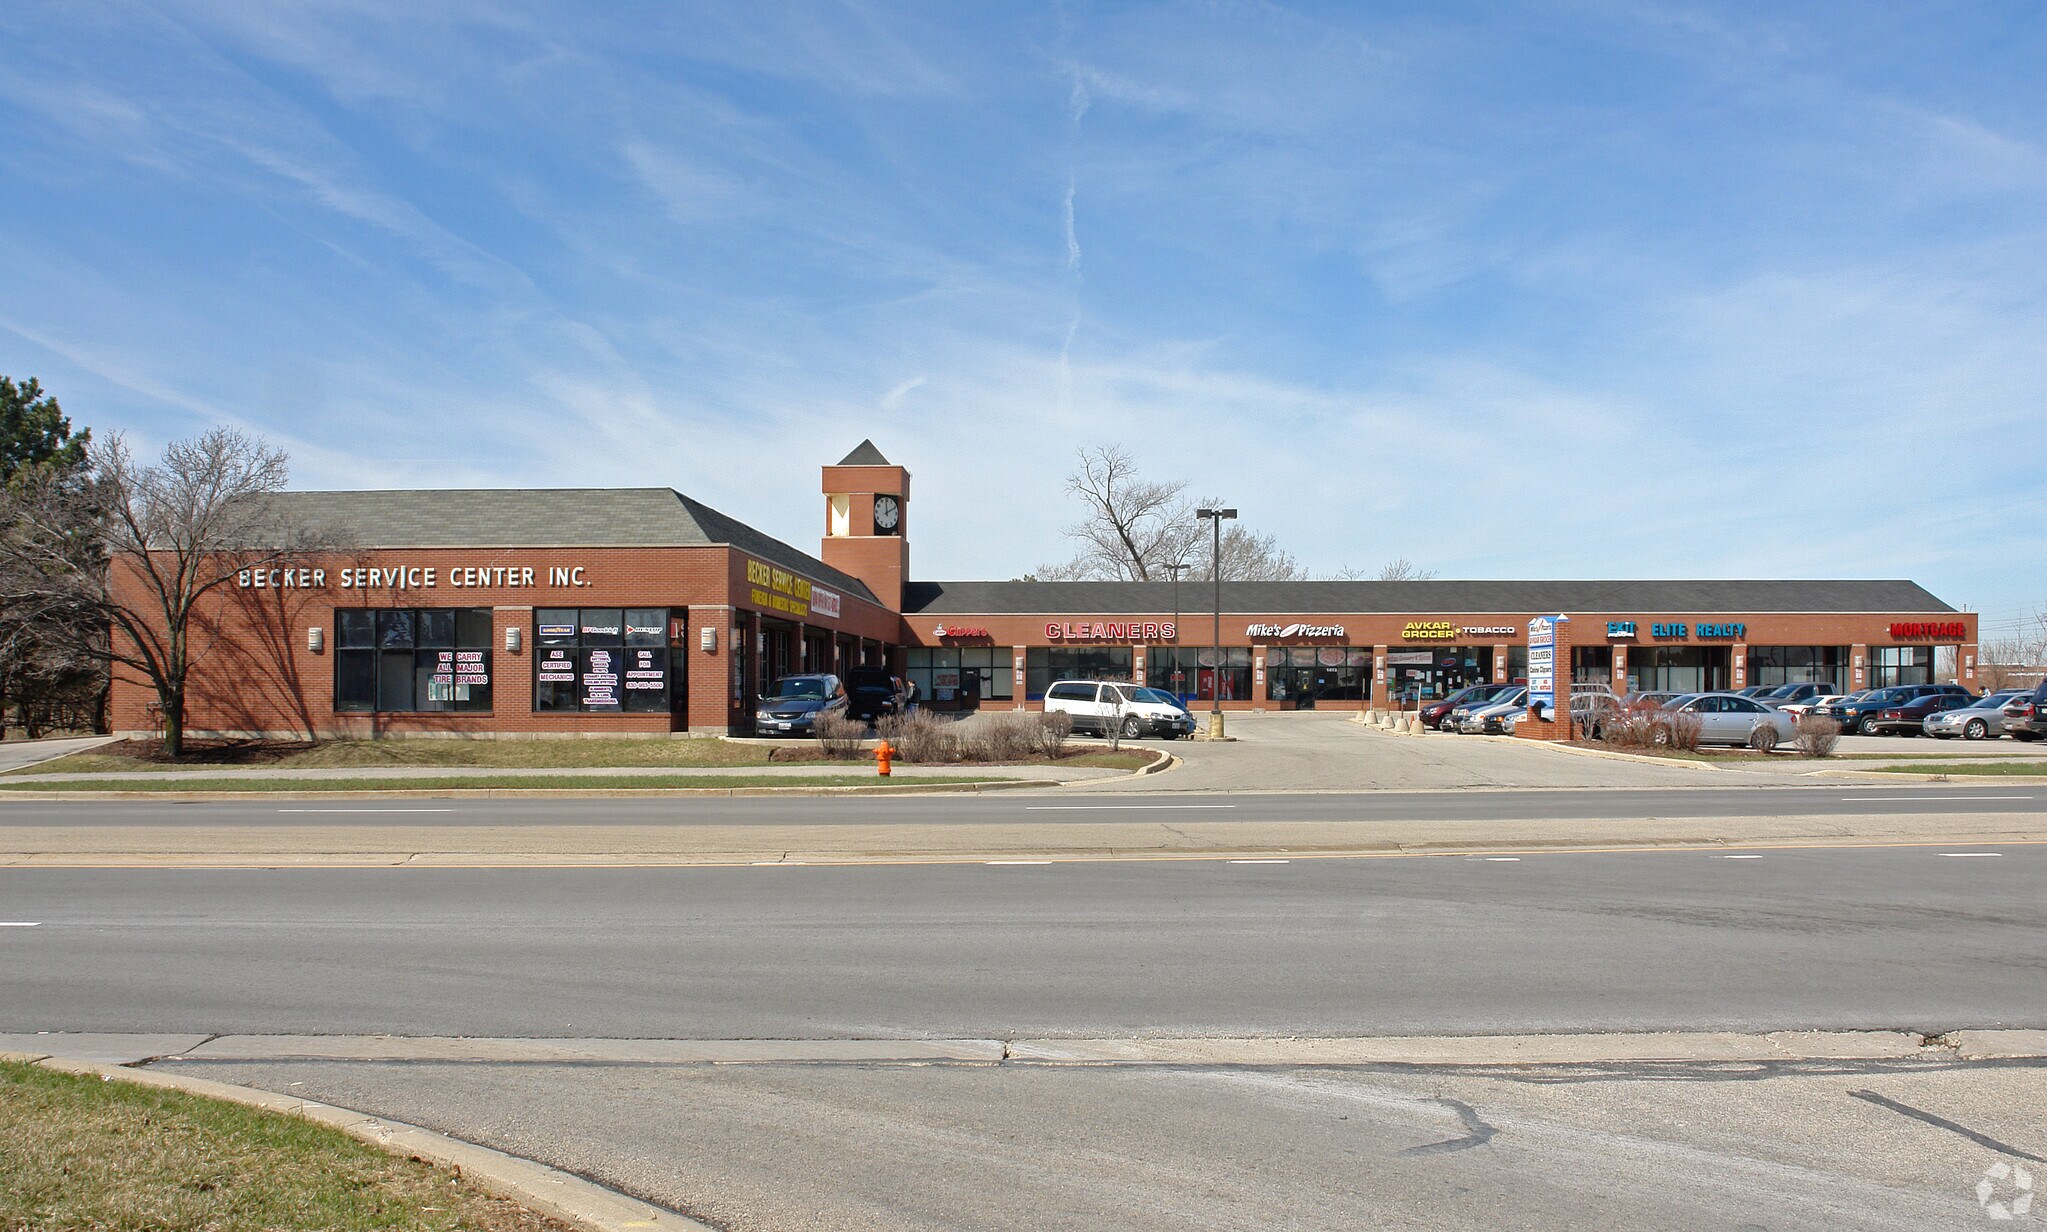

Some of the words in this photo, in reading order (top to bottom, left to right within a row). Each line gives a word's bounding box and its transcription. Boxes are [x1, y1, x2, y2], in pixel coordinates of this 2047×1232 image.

[238, 567, 325, 588] BECKER
[340, 565, 437, 589] SERVICE
[450, 567, 535, 586] CENTER
[549, 566, 592, 586] INC.
[747, 559, 770, 588] BECKER
[772, 567, 793, 595] SERVICE
[794, 576, 811, 601] CENTER
[1044, 622, 1176, 639] CLEANERS
[1246, 623, 1282, 637] Mike's
[1297, 623, 1345, 637] Pizzeria
[1401, 630, 1454, 638] GROCER
[1462, 626, 1515, 634] TOBACCO
[1651, 623, 1687, 637] ELITE
[1696, 623, 1745, 637] REALTY
[1891, 622, 1965, 637] MORTGAGE
[439, 652, 452, 661] WE
[456, 652, 482, 661] CARRY
[437, 663, 452, 672] ALL
[456, 663, 484, 672] MAJOR
[434, 675, 452, 684] TIRE
[456, 675, 487, 684] BRANDS
[540, 673, 574, 681] MECHANICS
